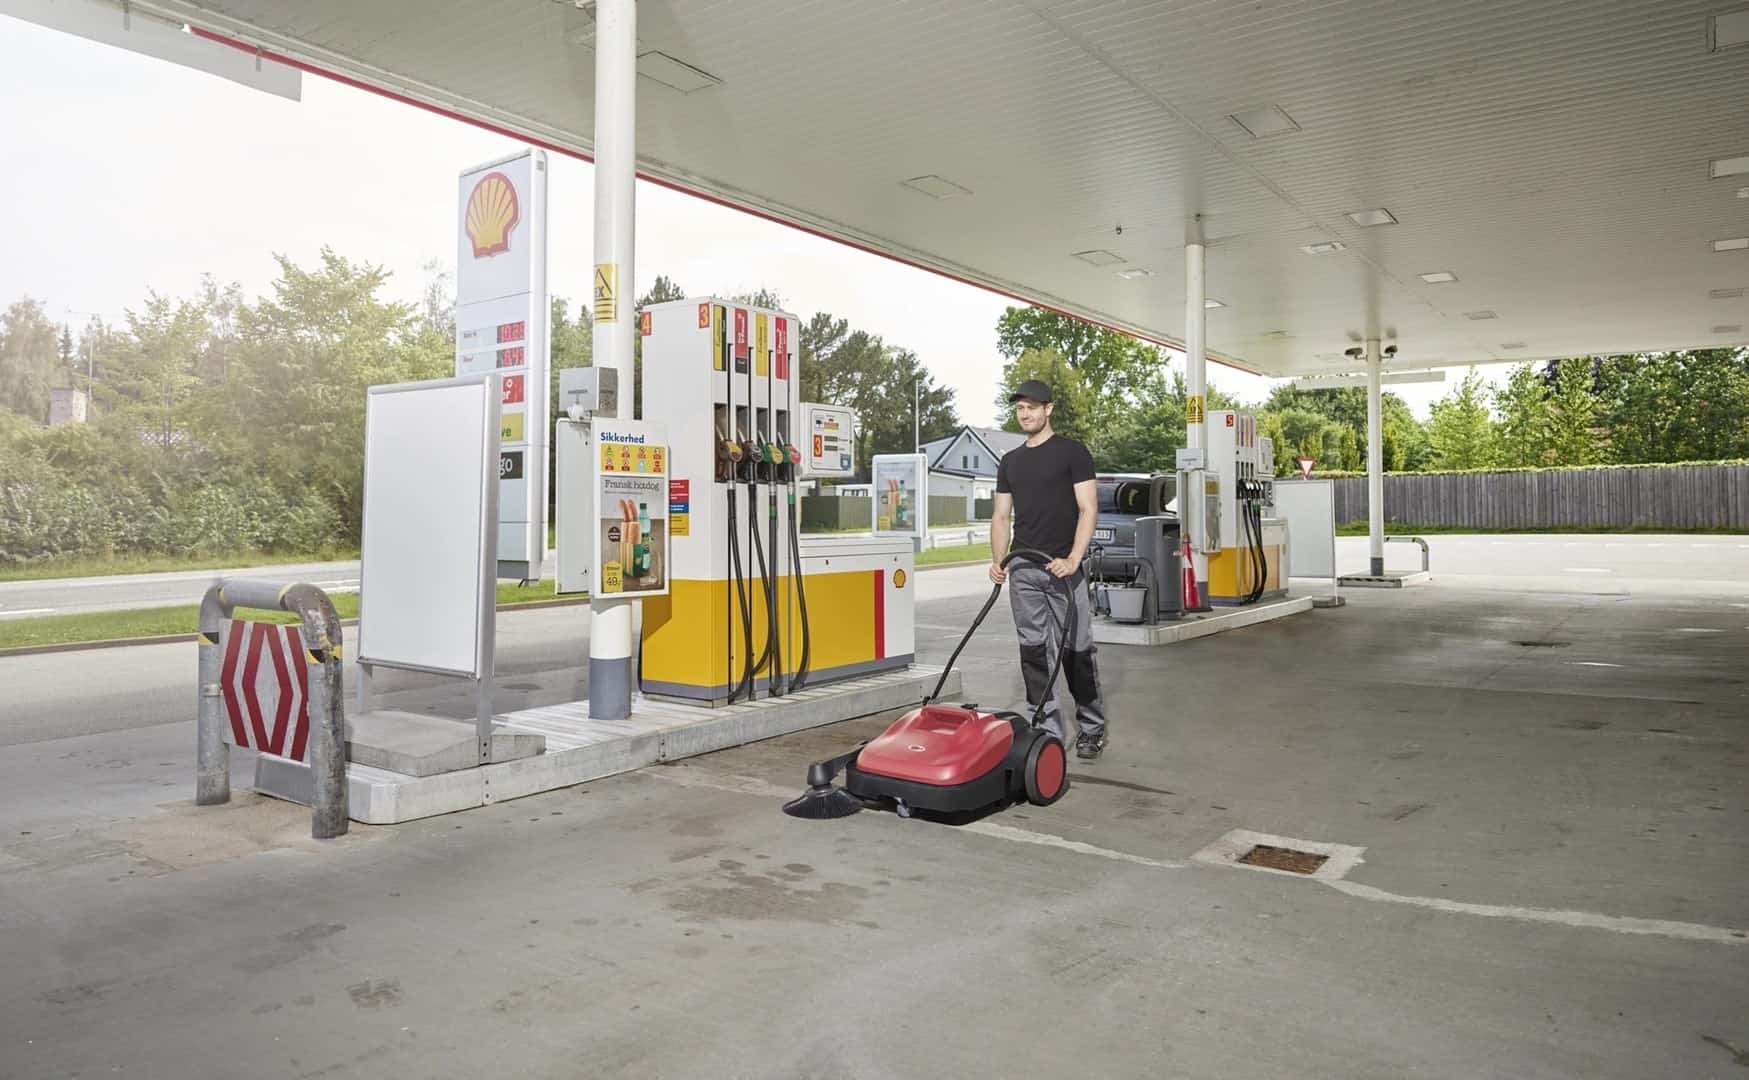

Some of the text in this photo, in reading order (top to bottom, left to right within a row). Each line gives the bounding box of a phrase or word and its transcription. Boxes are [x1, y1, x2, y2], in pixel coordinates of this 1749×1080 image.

[643, 315, 650, 332] 4
[700, 305, 709, 325] 3
[600, 432, 645, 444] Sikkerhed
[815, 436, 822, 456] 3
[605, 480, 633, 489] Fransk
[633, 480, 660, 492] hotdog
